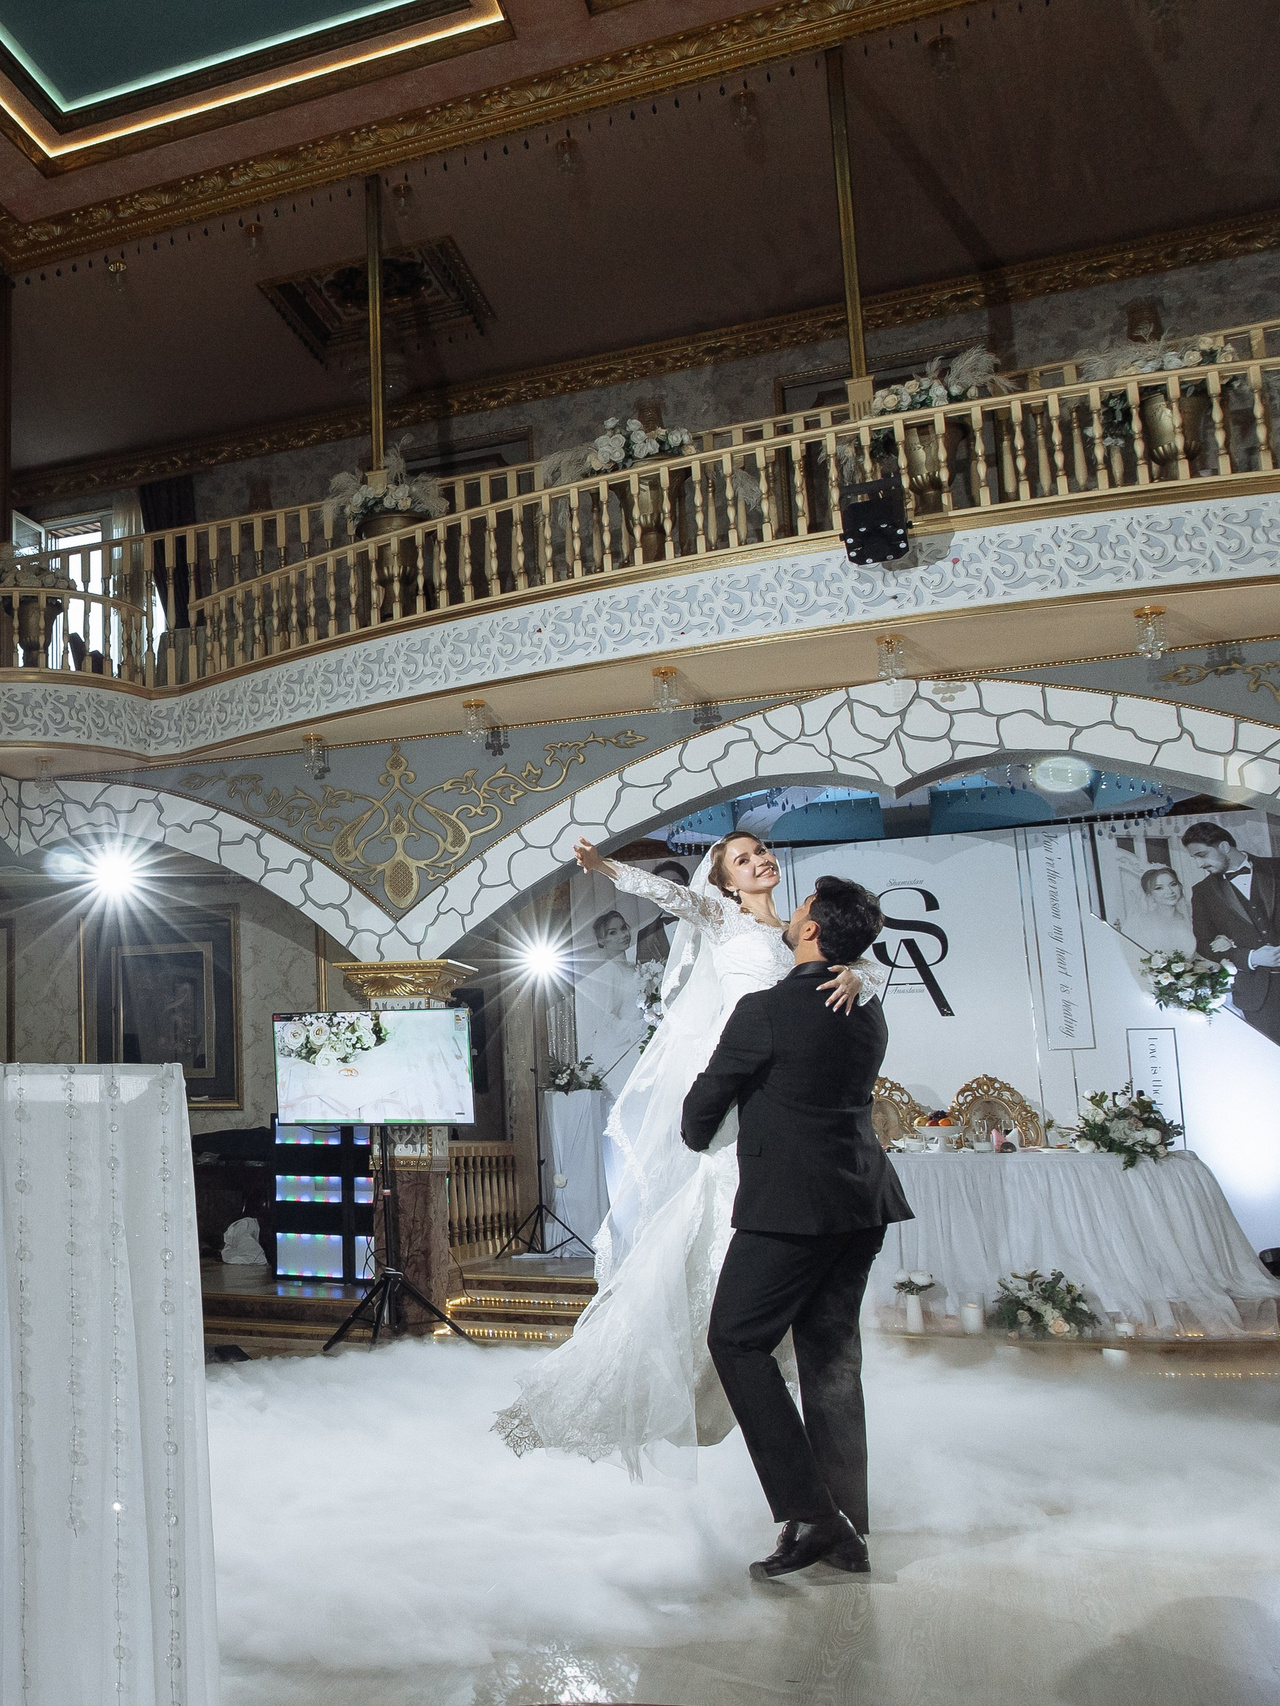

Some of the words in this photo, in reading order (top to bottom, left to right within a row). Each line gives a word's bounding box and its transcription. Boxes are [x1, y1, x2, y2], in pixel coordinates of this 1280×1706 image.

[1048, 925, 1064, 943] my
[1055, 947, 1072, 977] heart
[1060, 984, 1072, 994] is
